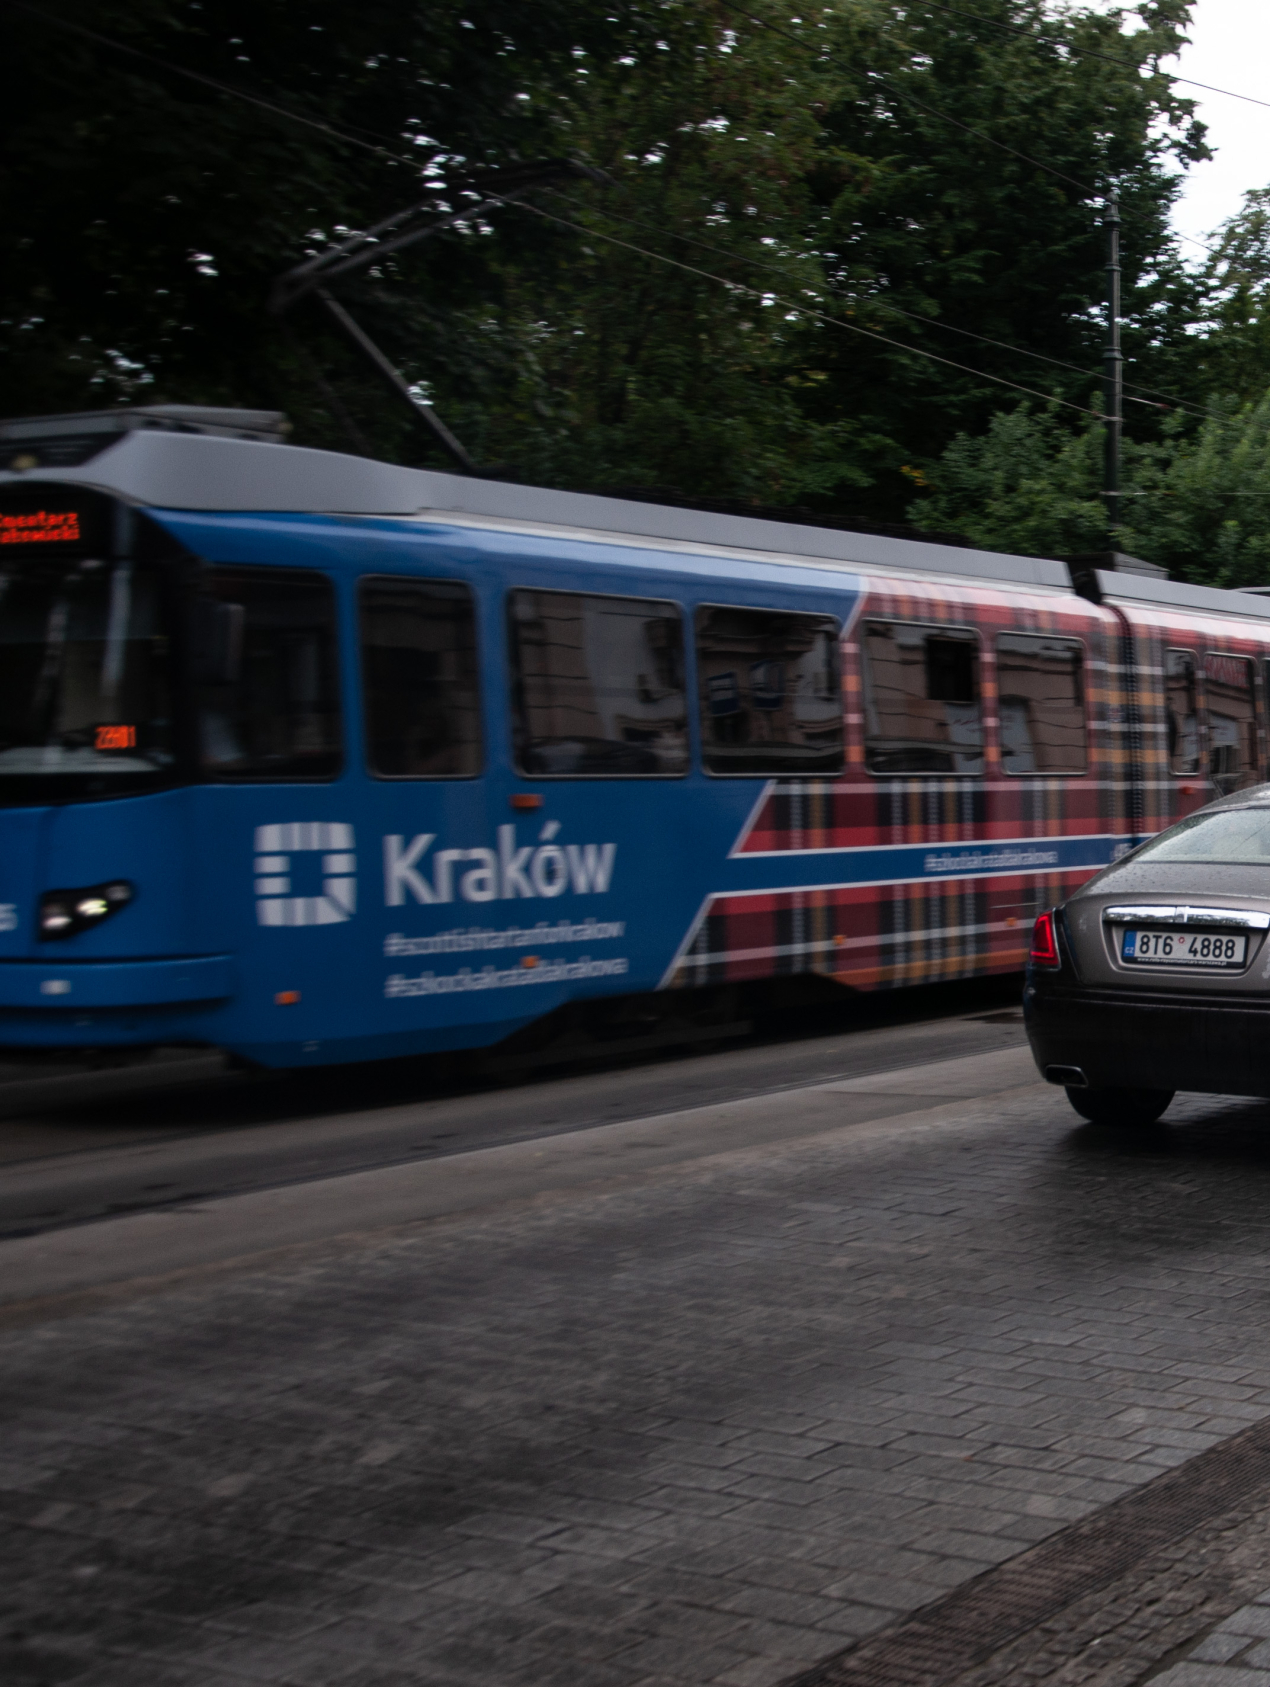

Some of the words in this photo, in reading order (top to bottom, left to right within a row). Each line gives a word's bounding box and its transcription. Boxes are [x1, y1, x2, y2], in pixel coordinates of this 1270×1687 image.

[383, 820, 617, 907] Kraków
[1125, 946, 1135, 954] CZ
[1139, 934, 1174, 956] 8T6
[1188, 936, 1236, 960] 4888
